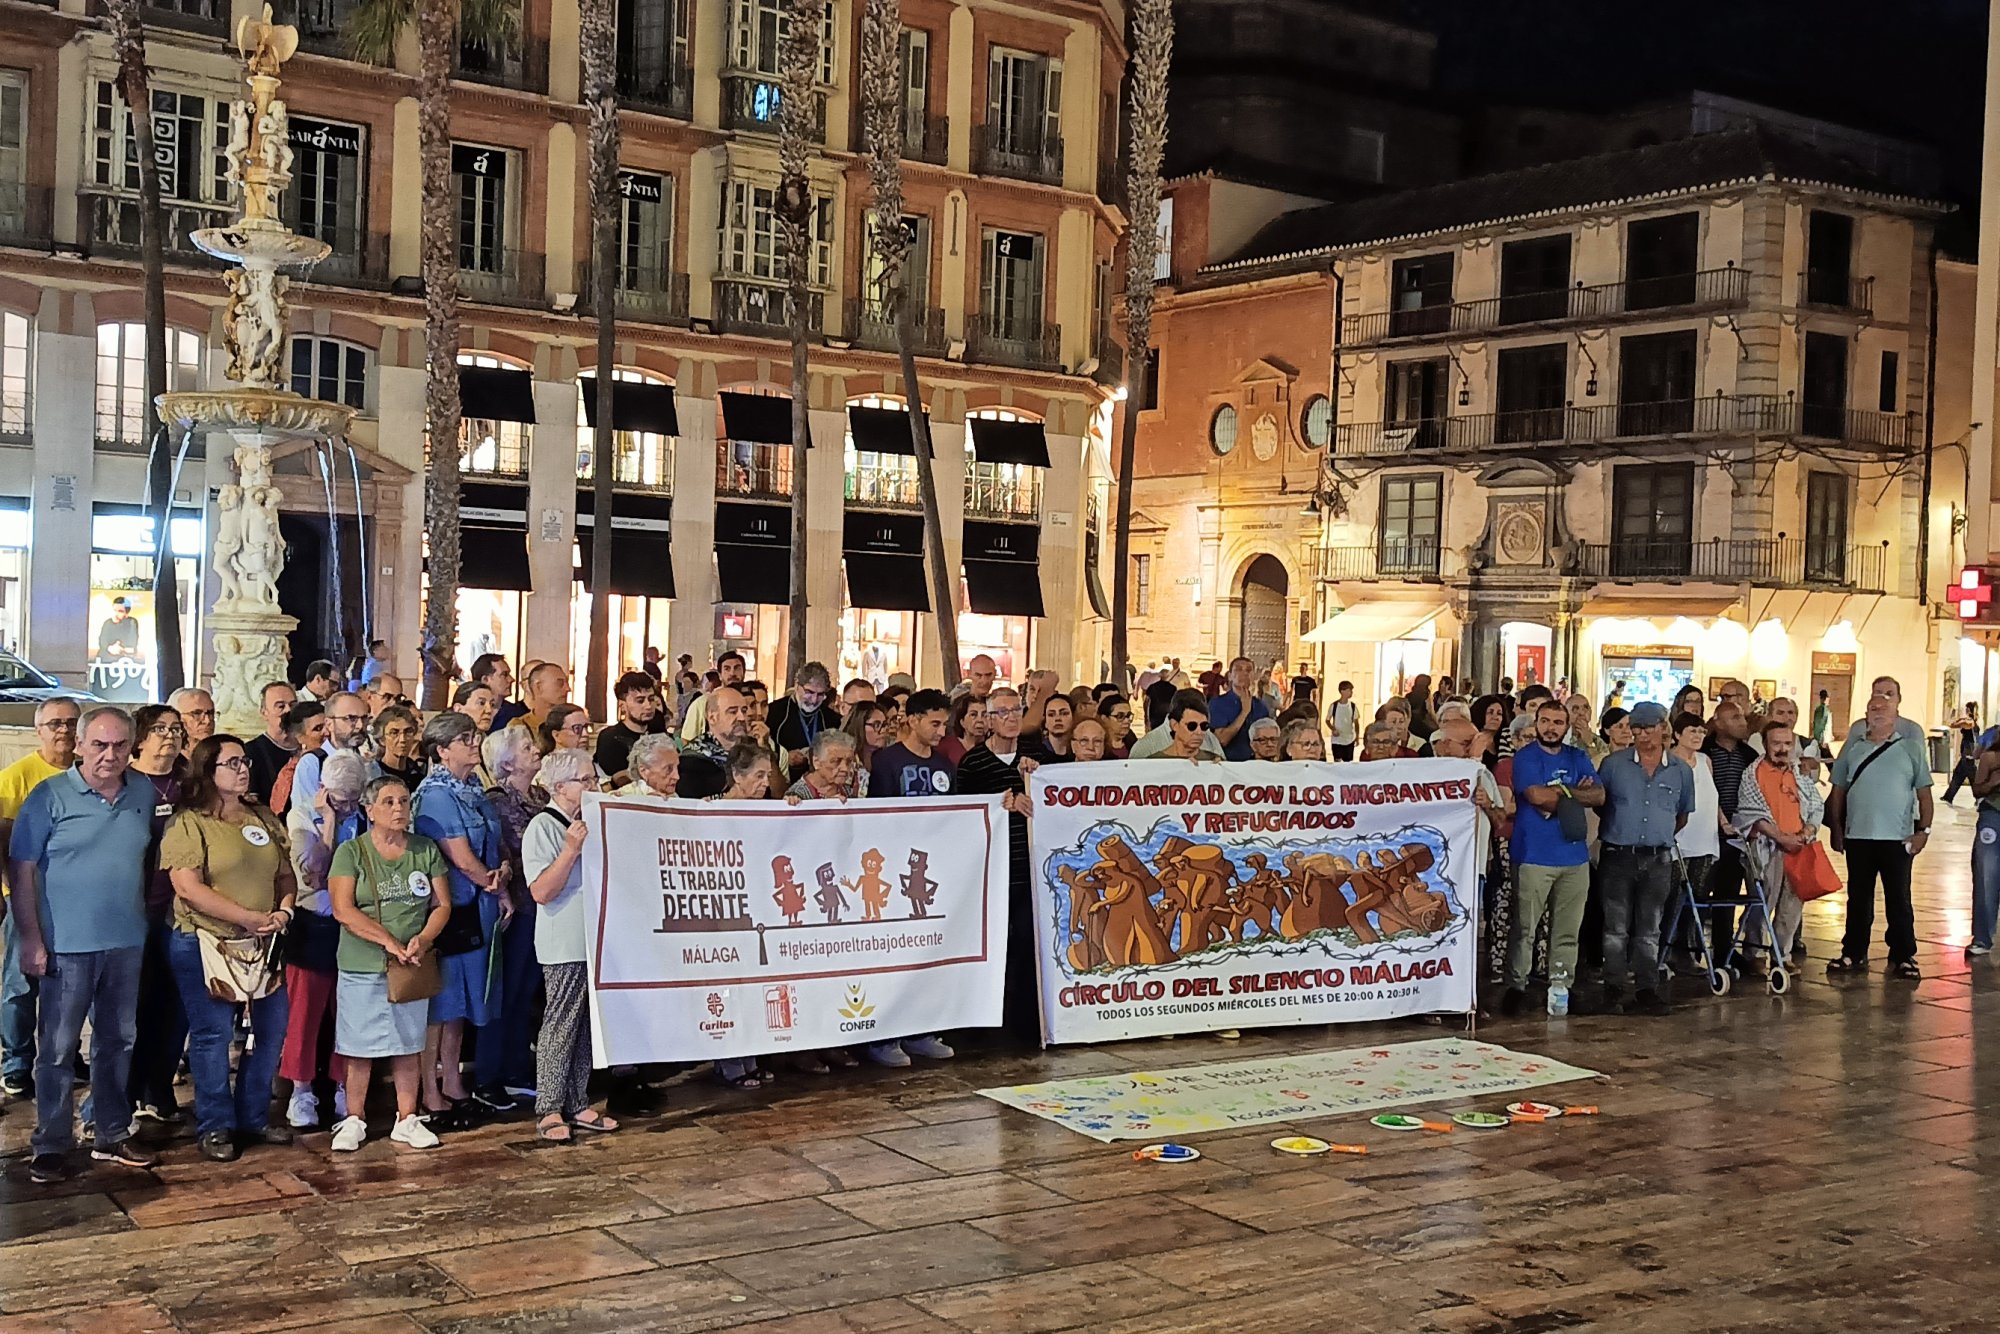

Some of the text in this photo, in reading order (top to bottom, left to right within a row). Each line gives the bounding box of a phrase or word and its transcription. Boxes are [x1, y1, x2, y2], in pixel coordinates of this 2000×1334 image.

[1044, 779, 1471, 807] SOLIDARIDAD CON LOS MIGRANTES
[1181, 811, 1358, 833] Y REFUGIADOS
[658, 838, 745, 868] DEFENDEMOS
[660, 870, 745, 891] EL TRABAJO
[663, 894, 750, 920] DECENTE
[682, 944, 740, 965] MÁLAGA
[779, 931, 944, 961] #Iglesiaporeltrabajodecente
[1059, 957, 1454, 1008] CÍRCULO DEL SILENCIO MÁLAGA
[1097, 1007, 1132, 1021] TODOS
[1134, 1006, 1154, 1017] LOS
[1157, 1002, 1215, 1016] SEGUNDOS
[1217, 996, 1277, 1012] MIÉRCOLES
[1279, 993, 1300, 1006] DEL
[1302, 993, 1324, 1005] MES
[1327, 992, 1341, 1003] DE
[1344, 990, 1374, 1002] 20:00
[1376, 990, 1385, 1000] A
[1387, 987, 1411, 999] 20:30
[840, 1019, 876, 1032] CONFER
